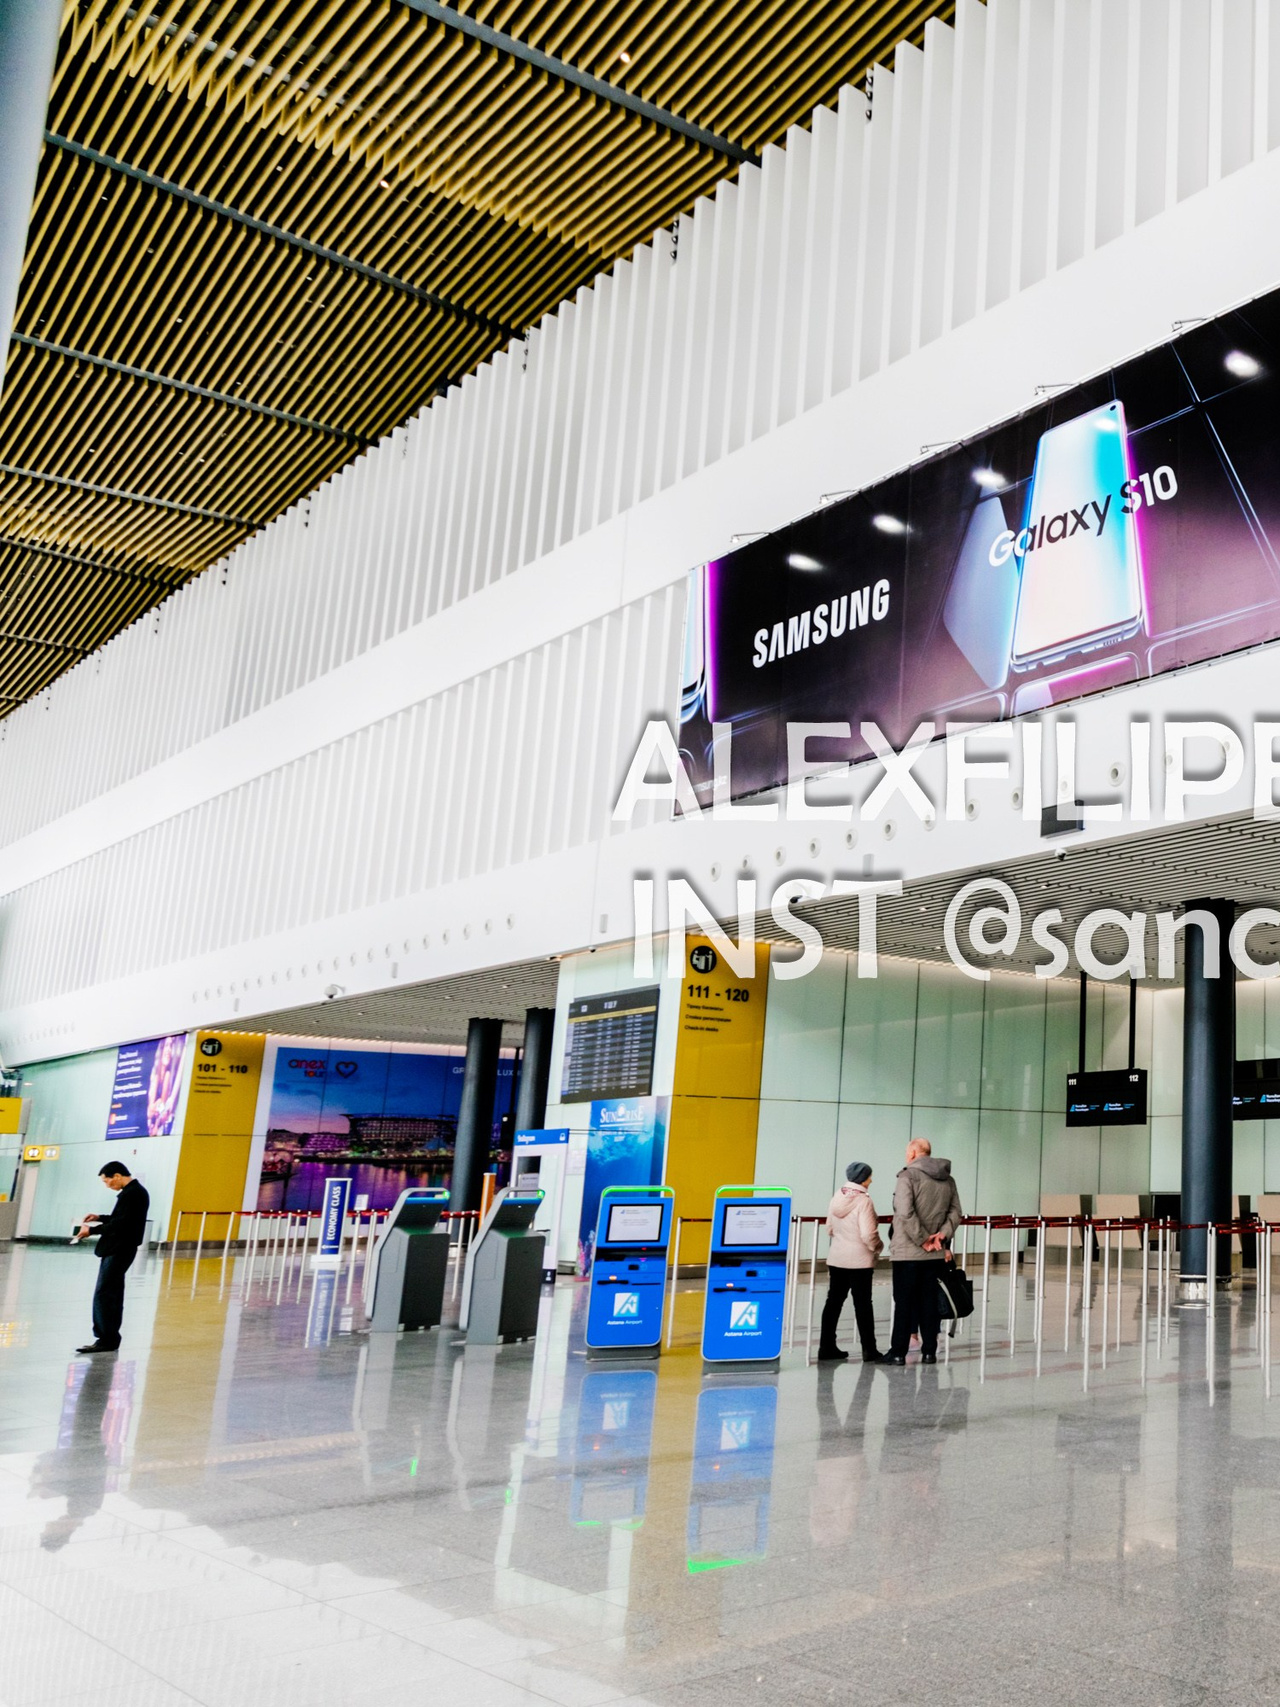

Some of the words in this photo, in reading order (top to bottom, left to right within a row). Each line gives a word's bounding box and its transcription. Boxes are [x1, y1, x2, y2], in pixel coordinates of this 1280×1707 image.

[988, 494, 1111, 567] Galaxy
[1119, 465, 1178, 514] S10
[752, 578, 891, 668] SAMSUNG
[687, 984, 709, 998] 111
[724, 988, 749, 1002] 120
[198, 1064, 216, 1072] 101
[229, 1065, 248, 1074] 110
[288, 1059, 325, 1069] anex
[331, 1186, 341, 1207] CLASS
[326, 1208, 339, 1240] ECONOMY
